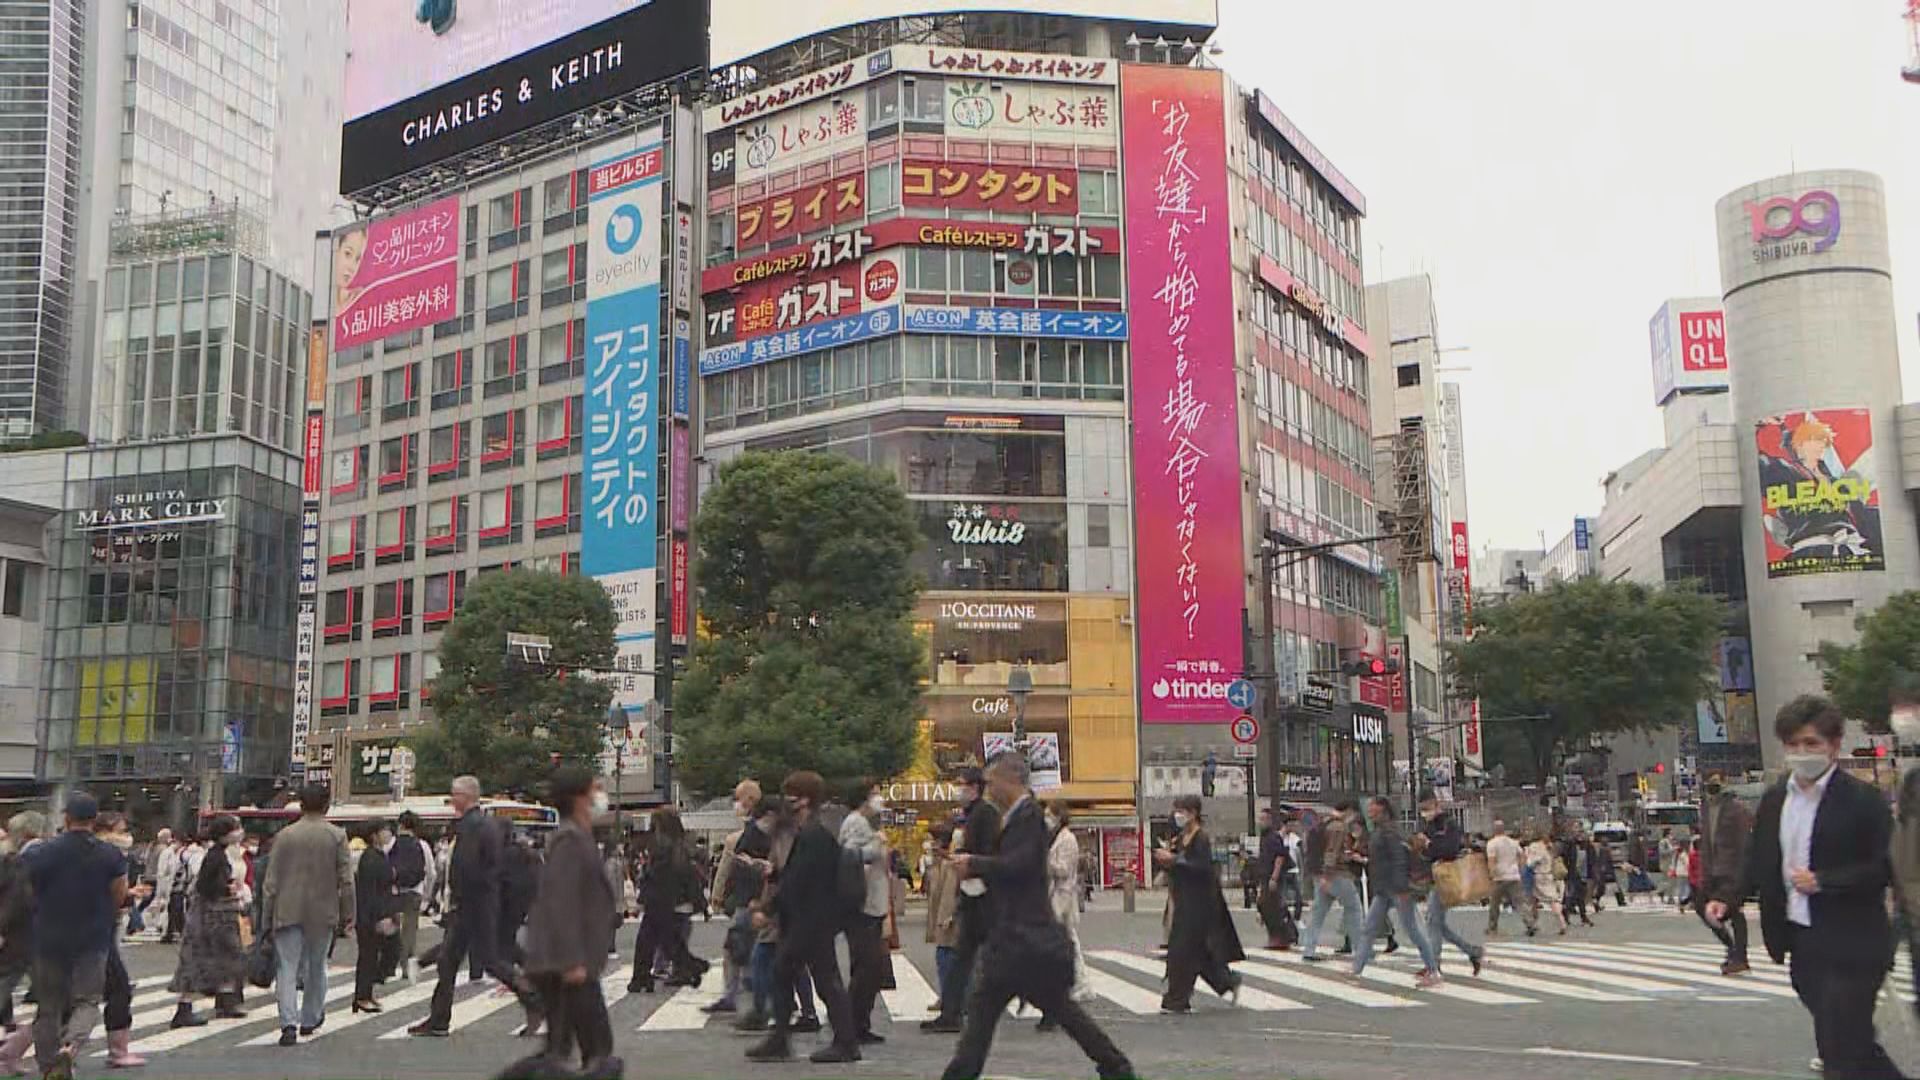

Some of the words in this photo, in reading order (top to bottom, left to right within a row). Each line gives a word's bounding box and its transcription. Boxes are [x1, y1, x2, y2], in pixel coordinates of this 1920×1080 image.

[928, 49, 1107, 79] しゃぶしゃぶバイキング
[401, 88, 503, 146] CHARLES
[517, 78, 533, 103] &
[550, 42, 624, 91] KEITH
[720, 63, 855, 124] しゃぶしゃぶバイキング
[780, 102, 857, 151] しゃぶ葉
[1004, 92, 1109, 129] しゃぶ葉
[596, 153, 656, 189] 当ビル5F
[711, 148, 735, 172] 9F
[903, 166, 1073, 204] コンタクト
[739, 180, 862, 240] プライス
[1743, 190, 1841, 254] 109
[388, 211, 454, 248] 品川スキン
[1023, 226, 1101, 257] ガスト
[388, 235, 446, 269] クリニック
[810, 230, 873, 269] ガスト
[1752, 240, 1809, 264] SHIBUYA
[595, 253, 651, 285] eyecity
[868, 276, 897, 292] ガスト
[351, 282, 450, 336] 品川美容外科
[742, 298, 774, 320] Café
[777, 278, 854, 328] ガスト
[913, 310, 962, 325] AEON
[707, 308, 735, 336] 7F
[1686, 318, 1722, 340] UN
[705, 349, 740, 366] AEON
[1689, 342, 1725, 368] QL
[591, 329, 624, 529] アイシティ
[624, 323, 649, 525] コンタクトの
[115, 489, 186, 505] SHIBUYA
[1765, 478, 1872, 510] BLEACH
[77, 506, 153, 526] MARK
[164, 499, 227, 518] CITY
[941, 601, 1037, 620] L'OCCITANE
[1171, 678, 1233, 700] tinder
[972, 697, 1009, 717] Café
[1352, 712, 1383, 745] LUSH
